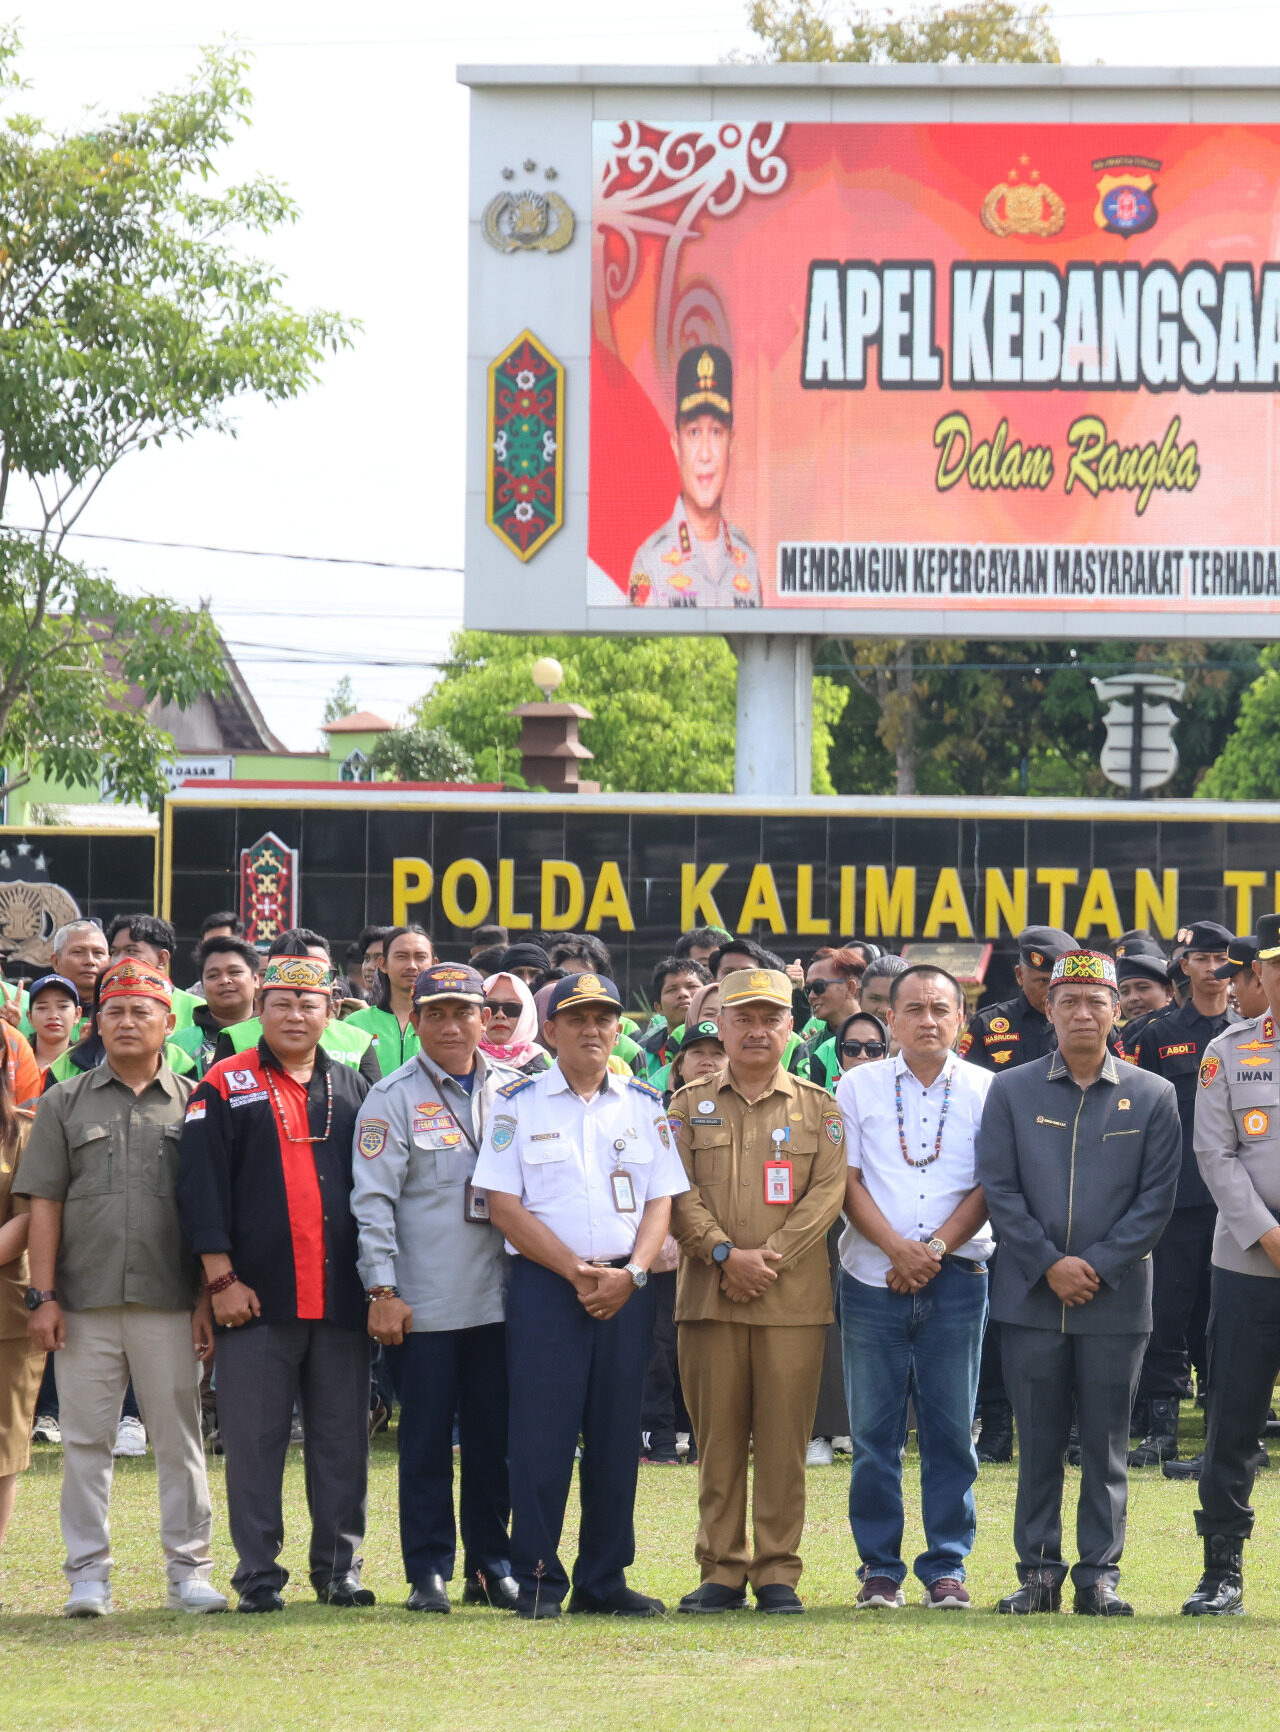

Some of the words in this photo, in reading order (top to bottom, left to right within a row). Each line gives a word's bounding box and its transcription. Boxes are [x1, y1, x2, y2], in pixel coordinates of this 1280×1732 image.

[801, 261, 942, 389] APEL
[933, 410, 1053, 492] Dalam
[1064, 414, 1200, 517] Rangka
[781, 547, 907, 592] MEMBANGUN
[913, 549, 1048, 594] KEPERCAYAAN
[1054, 550, 1183, 595] MASYARAKAT
[393, 857, 635, 932] POLDA
[681, 862, 1179, 940] KALIMANTAN
[1166, 1044, 1188, 1056] ABDI
[1237, 1071, 1273, 1081] IWAN
